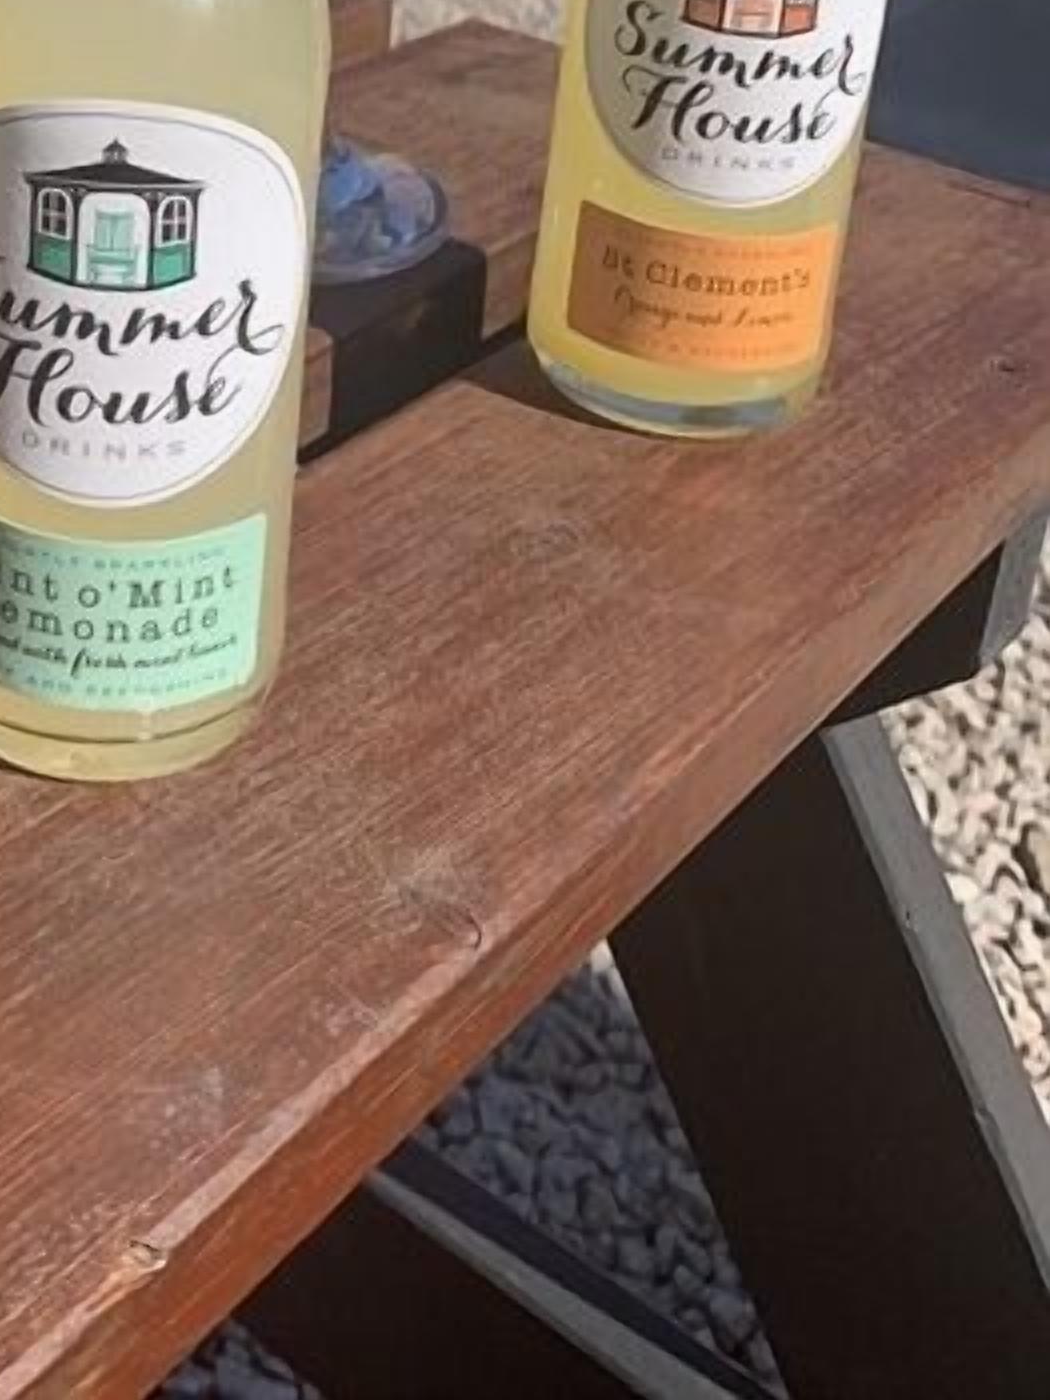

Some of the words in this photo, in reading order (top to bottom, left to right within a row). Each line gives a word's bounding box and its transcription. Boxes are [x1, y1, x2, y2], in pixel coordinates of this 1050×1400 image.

[614, 0, 867, 97] Summer
[622, 64, 837, 146] House
[645, 260, 811, 297] Clement's
[21, 429, 189, 460] DRINKS
[77, 565, 235, 609] o'Mint
